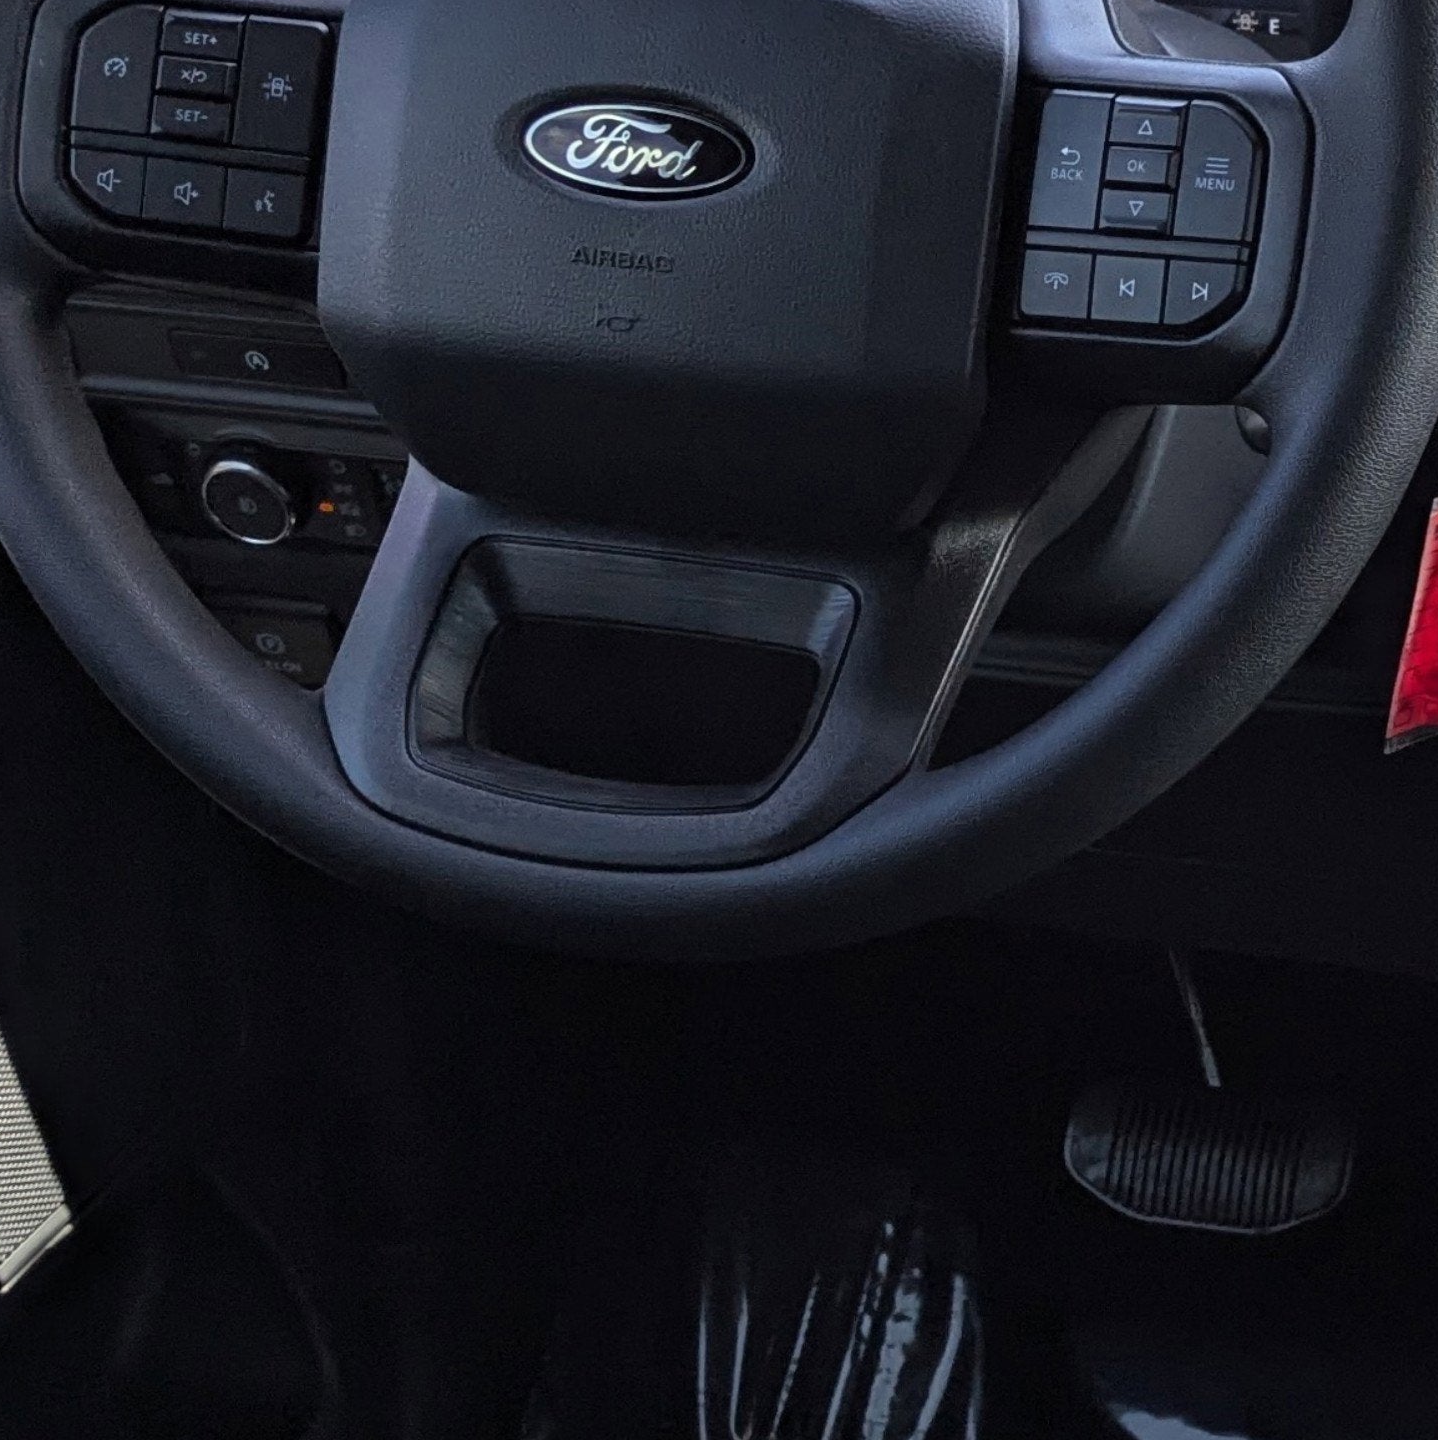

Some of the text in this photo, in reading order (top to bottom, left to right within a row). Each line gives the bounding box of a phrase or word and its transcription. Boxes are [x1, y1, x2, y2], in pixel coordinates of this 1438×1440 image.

[565, 112, 704, 182] Ford
[1050, 167, 1084, 181] BACK
[1127, 159, 1146, 174] OK
[1194, 176, 1236, 192] MENU
[570, 245, 674, 274] AIRBAG
